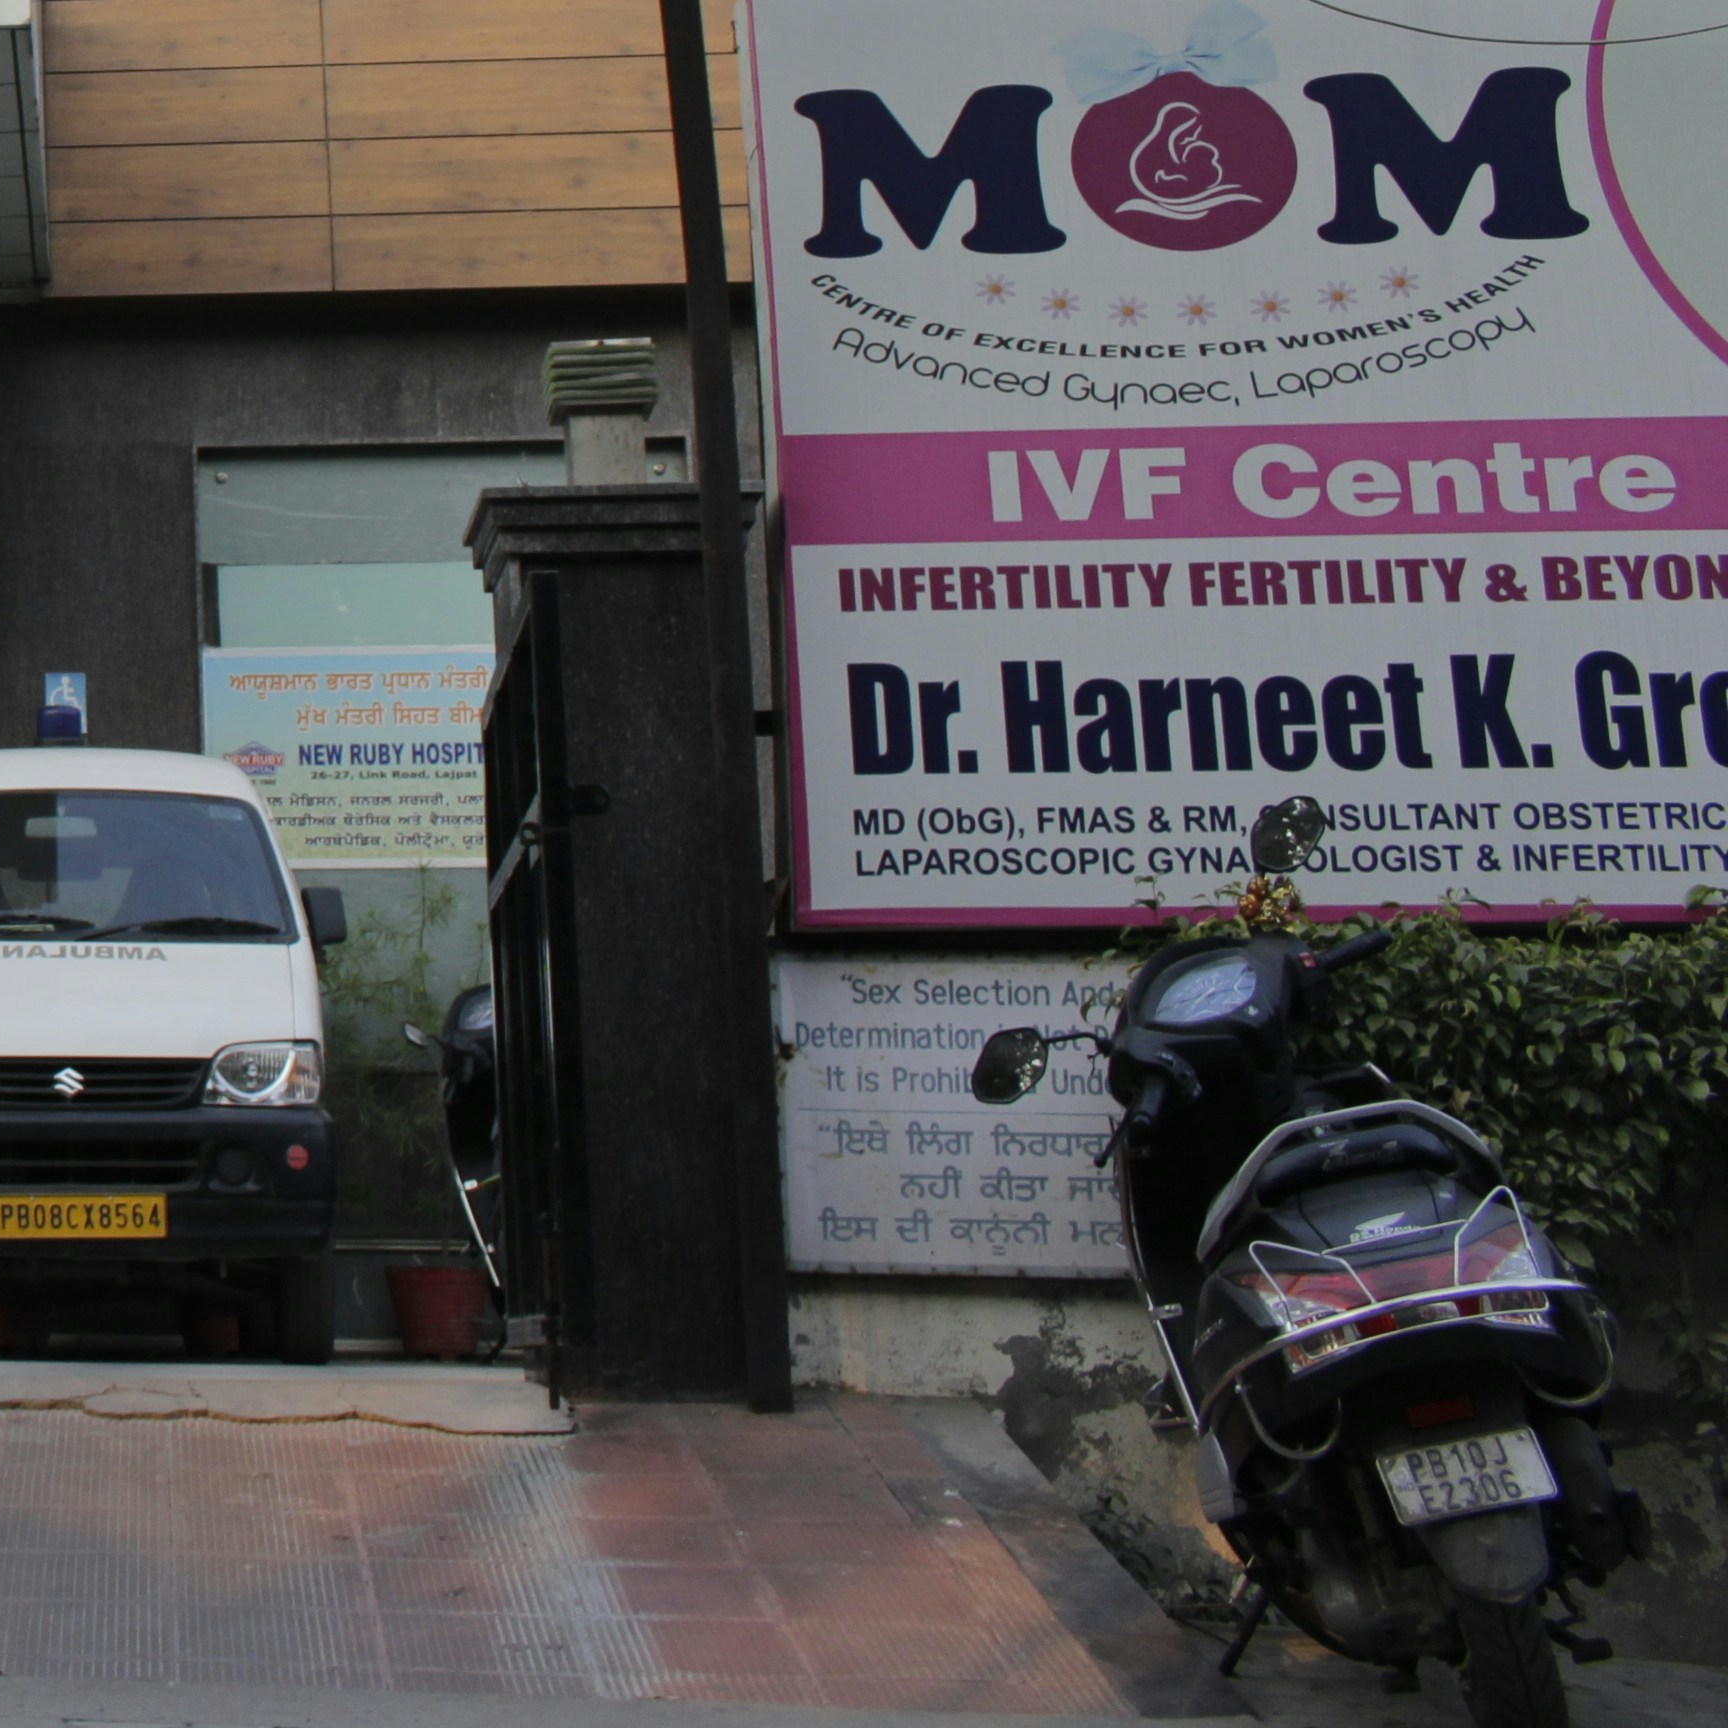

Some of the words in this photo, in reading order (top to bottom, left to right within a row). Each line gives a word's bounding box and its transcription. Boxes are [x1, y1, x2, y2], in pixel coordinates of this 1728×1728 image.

[811, 273, 916, 330] CENTRE
[922, 321, 966, 341] OF
[972, 332, 1187, 359] EXCELLENCE
[1199, 339, 1267, 358] FOR
[1277, 308, 1443, 352] WOMEN'S
[1444, 254, 1545, 314] HEALTH
[832, 327, 1051, 397] Advanced
[1063, 373, 1241, 412] Gynaec,
[1250, 306, 1536, 398] Laparoscopy
[987, 446, 1186, 523] IVF
[1232, 442, 1677, 519] Centre
[838, 563, 1173, 612] INFERTILITY
[1189, 558, 1467, 607] FERTILITY
[1484, 563, 1529, 603] &
[847, 662, 979, 775] Dr.
[1000, 660, 1433, 774] Harneet
[1449, 653, 1554, 769] K.
[298, 743, 344, 766] NEW
[350, 742, 405, 766] RUBY
[359, 769, 387, 780] Link
[435, 769, 478, 781] Lajpat
[852, 809, 905, 836] MD
[917, 806, 1025, 840] (ObG),
[1037, 806, 1136, 834] FMAS
[1147, 807, 1171, 834] &
[1183, 805, 1247, 837] RM,
[854, 846, 1136, 878] LAPAROSCOPIC
[1477, 845, 1502, 872] &
[914, 978, 1050, 1006] Selection
[795, 1021, 984, 1050] Determination
[826, 1067, 845, 1093] It
[858, 1065, 880, 1093] is
[1, 1203, 161, 1230] PB08CX8564
